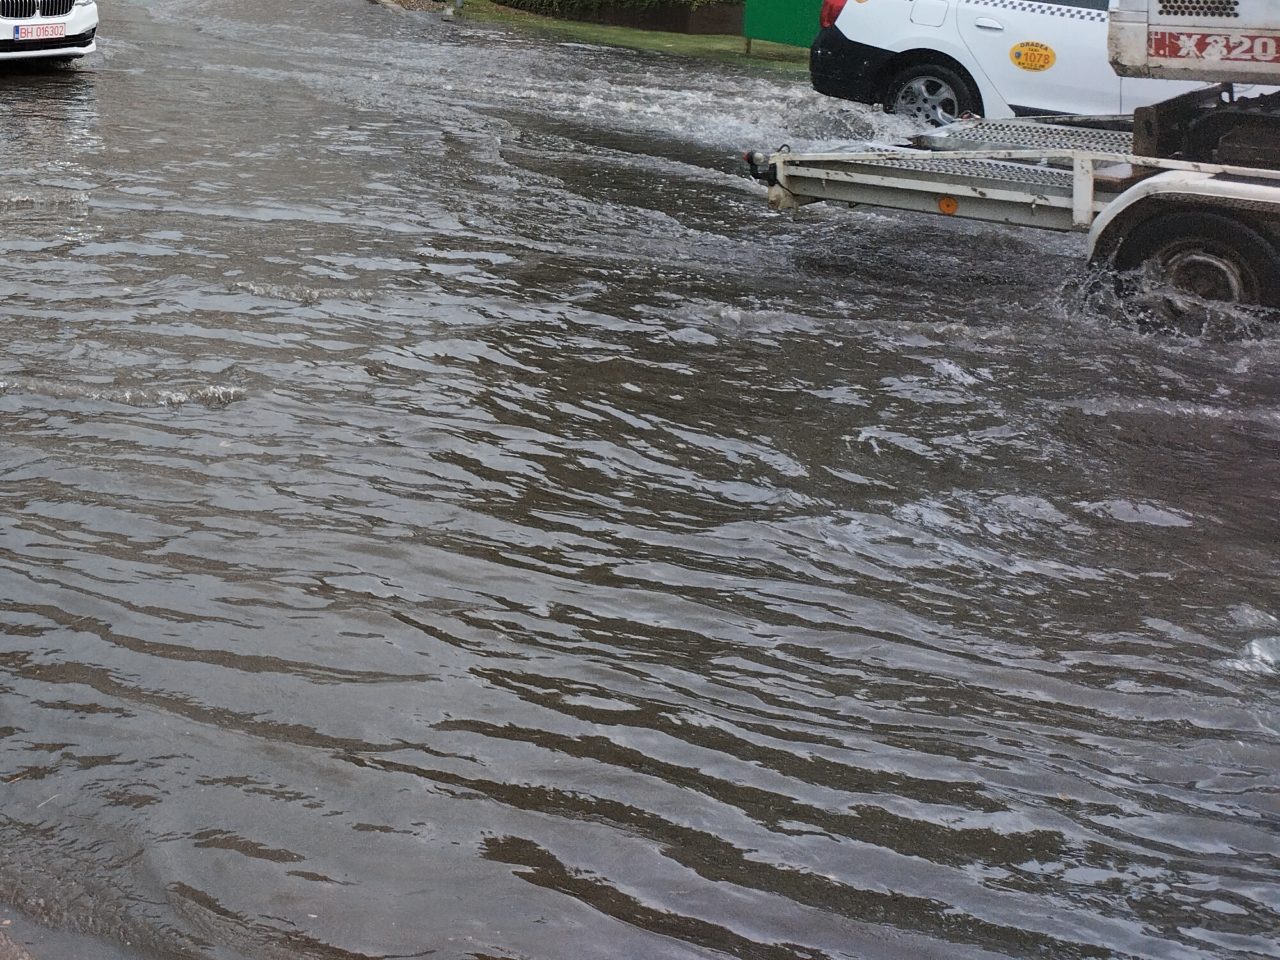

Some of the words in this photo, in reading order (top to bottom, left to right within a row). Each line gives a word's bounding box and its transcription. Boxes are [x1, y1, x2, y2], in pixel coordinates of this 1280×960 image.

[20, 28, 33, 38] BH
[36, 26, 64, 37] 016302
[1023, 52, 1051, 65] 1078
